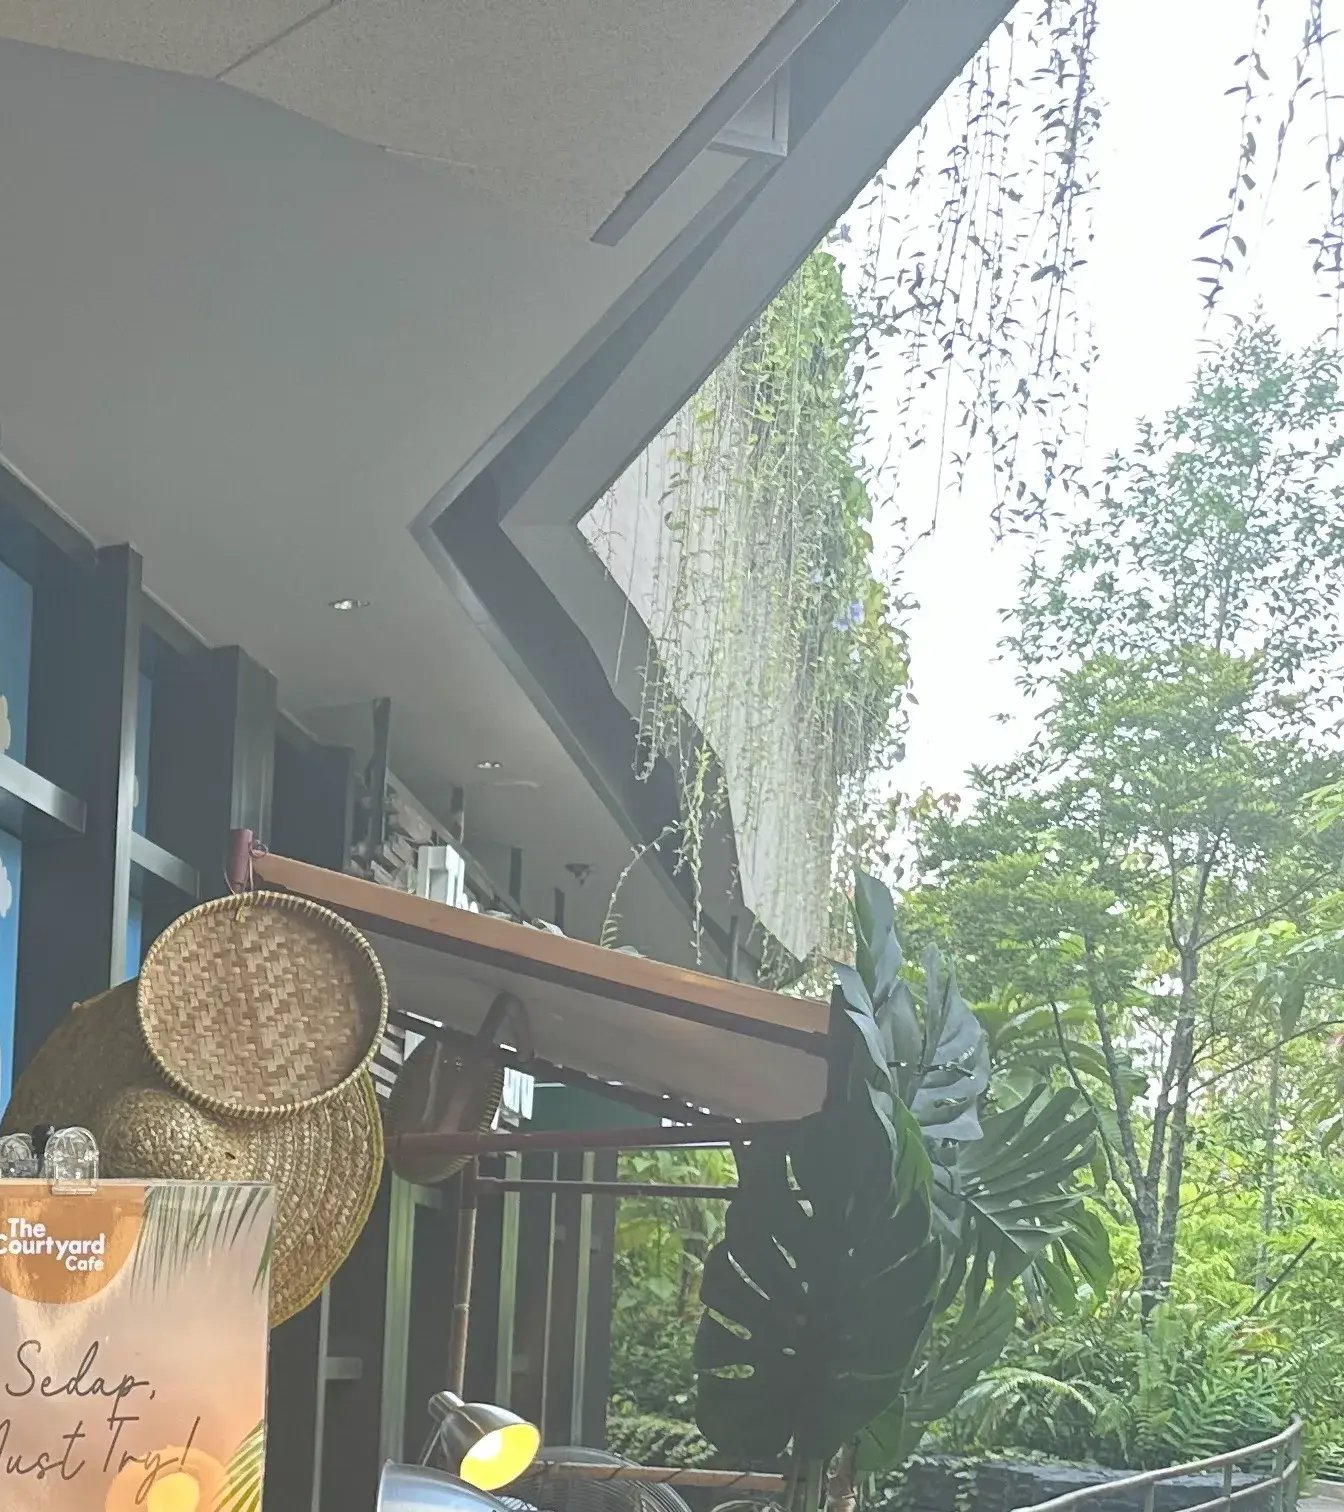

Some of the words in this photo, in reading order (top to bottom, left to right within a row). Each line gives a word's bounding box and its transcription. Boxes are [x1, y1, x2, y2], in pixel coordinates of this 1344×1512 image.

[7, 1217, 46, 1238] The
[64, 1255, 105, 1271] Cafe
[4, 1340, 157, 1428] Sedap,
[102, 1415, 201, 1505] Try!
